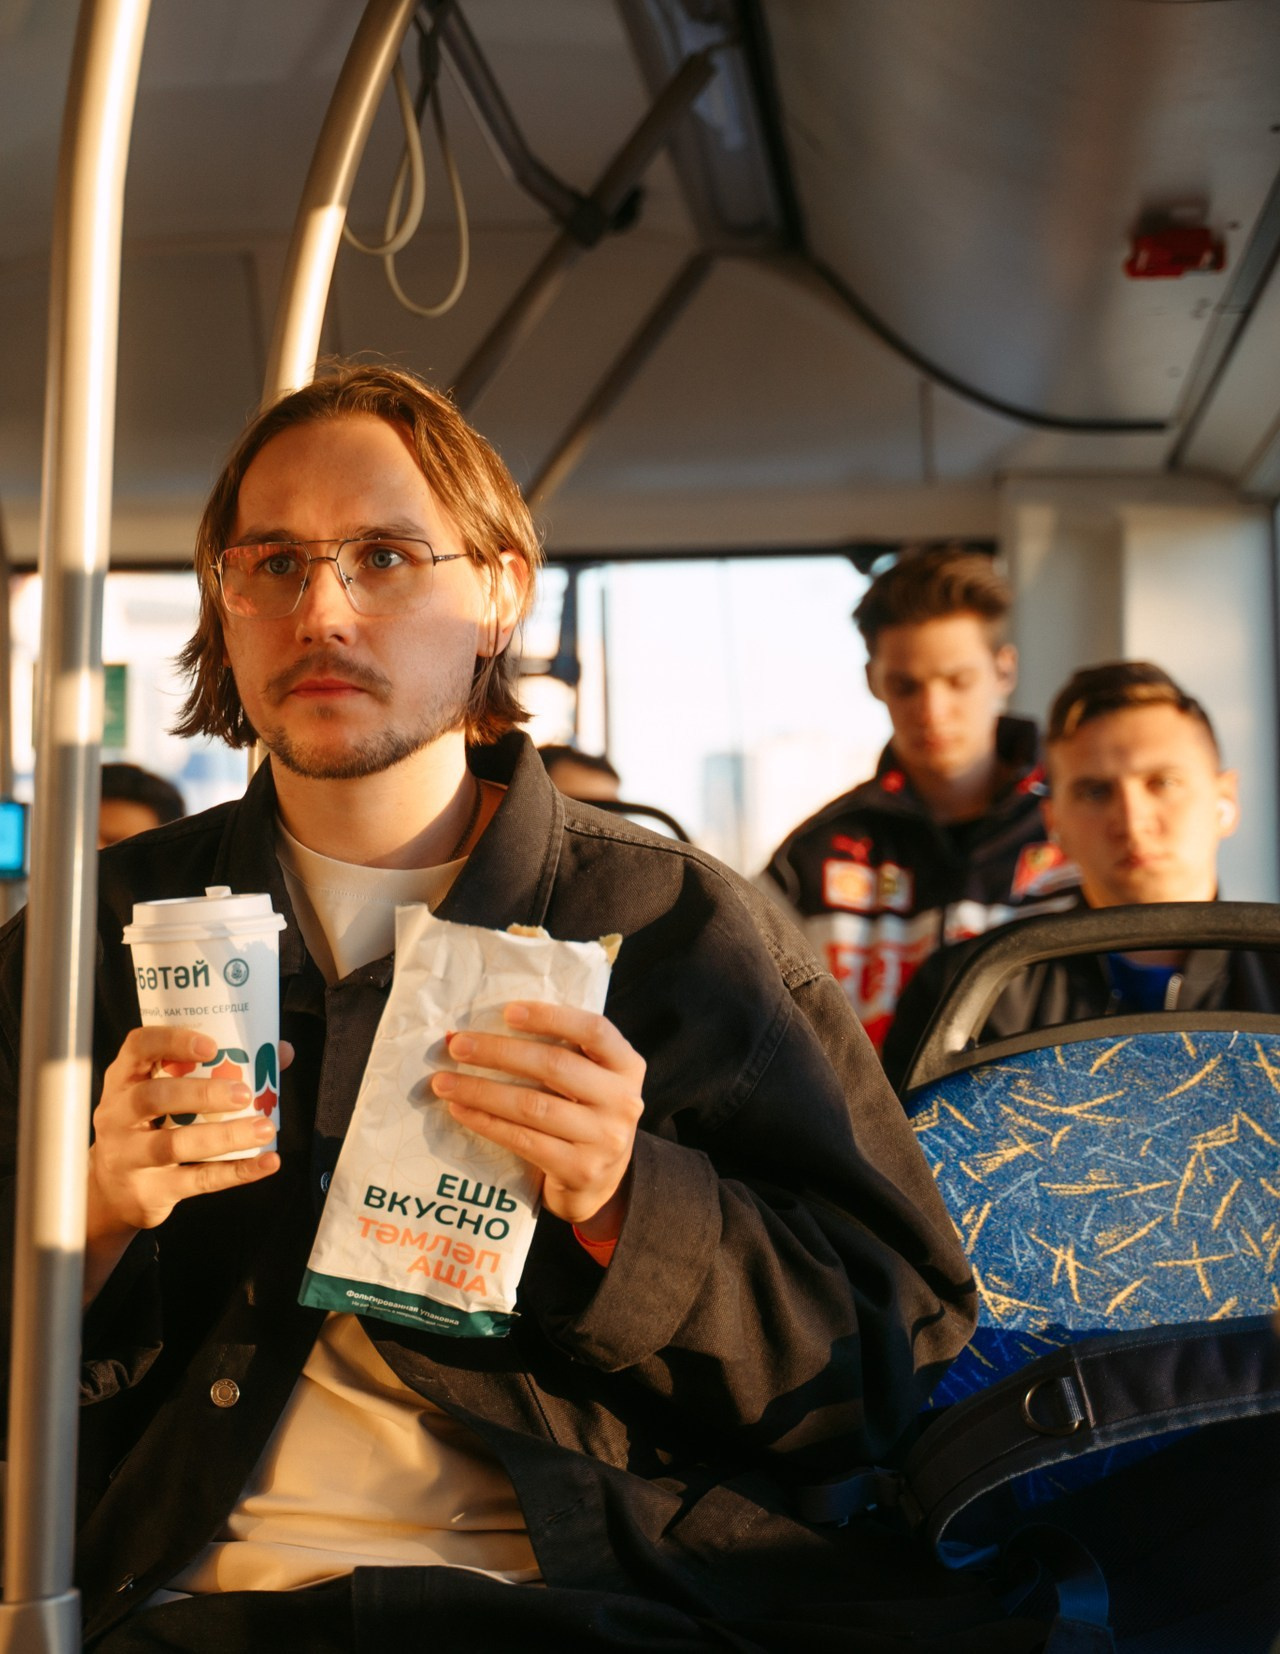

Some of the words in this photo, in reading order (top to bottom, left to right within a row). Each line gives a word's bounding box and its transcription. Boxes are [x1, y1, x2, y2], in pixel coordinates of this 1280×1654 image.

[136, 960, 210, 990] БӘТӘЙ
[164, 1007, 182, 1017] КАК
[184, 1006, 210, 1016] ТВОЕ
[211, 1002, 249, 1015] СЕРДЦЕ
[364, 1185, 510, 1240] ВКУСНО
[436, 1173, 518, 1213] ЕШЬ
[358, 1217, 501, 1273] ТӘМЛӘП
[407, 1255, 488, 1297] АША
[419, 1308, 460, 1326] упаковка
